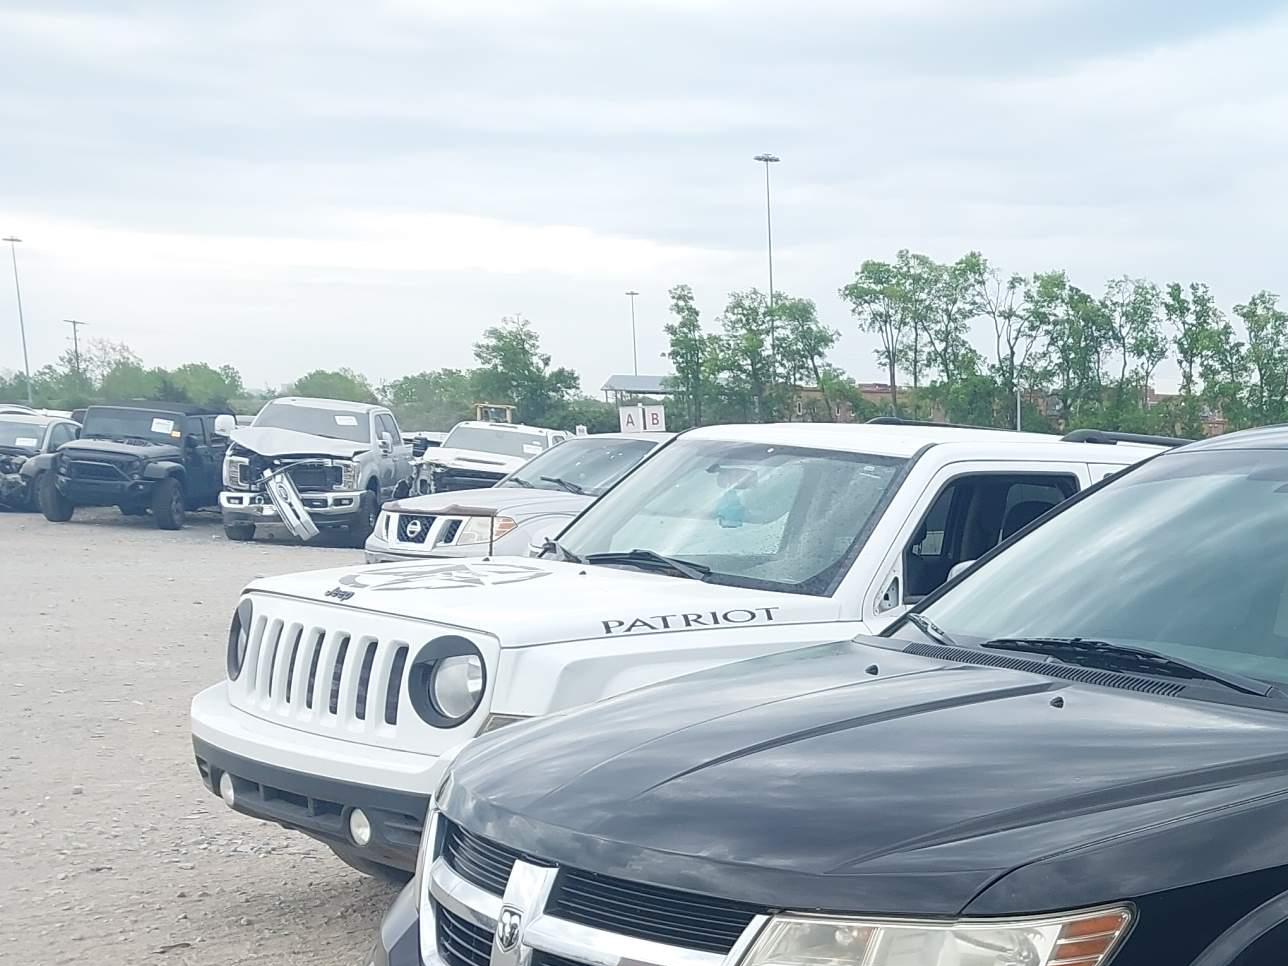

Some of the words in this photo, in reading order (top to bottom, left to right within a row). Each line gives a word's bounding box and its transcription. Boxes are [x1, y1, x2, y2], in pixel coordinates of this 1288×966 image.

[626, 413, 635, 427] A
[651, 412, 660, 426] B
[324, 586, 355, 602] Jeep
[601, 606, 780, 635] PATRIOT
